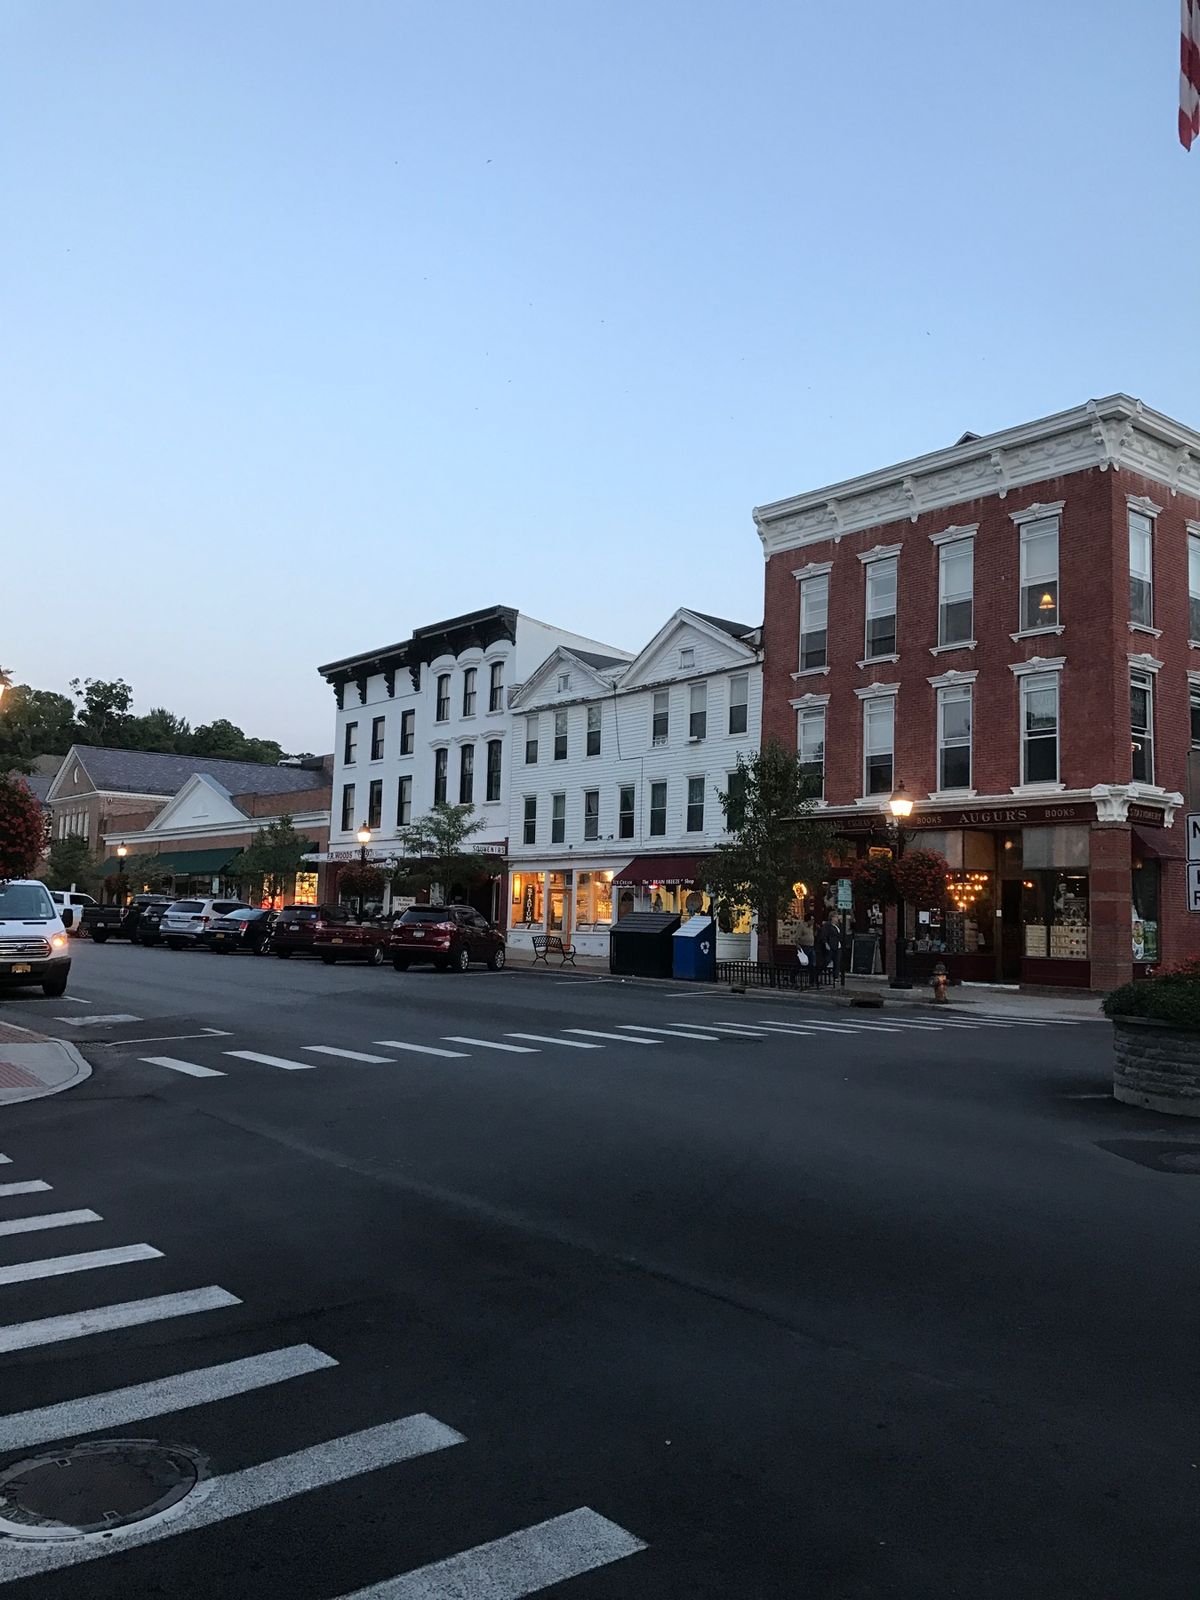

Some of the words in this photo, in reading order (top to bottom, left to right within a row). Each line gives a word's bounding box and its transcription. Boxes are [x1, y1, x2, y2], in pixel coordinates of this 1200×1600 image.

[917, 816, 942, 825] BOOKS
[959, 809, 1028, 824] AUGUR'S
[1045, 808, 1076, 818] BOOKS
